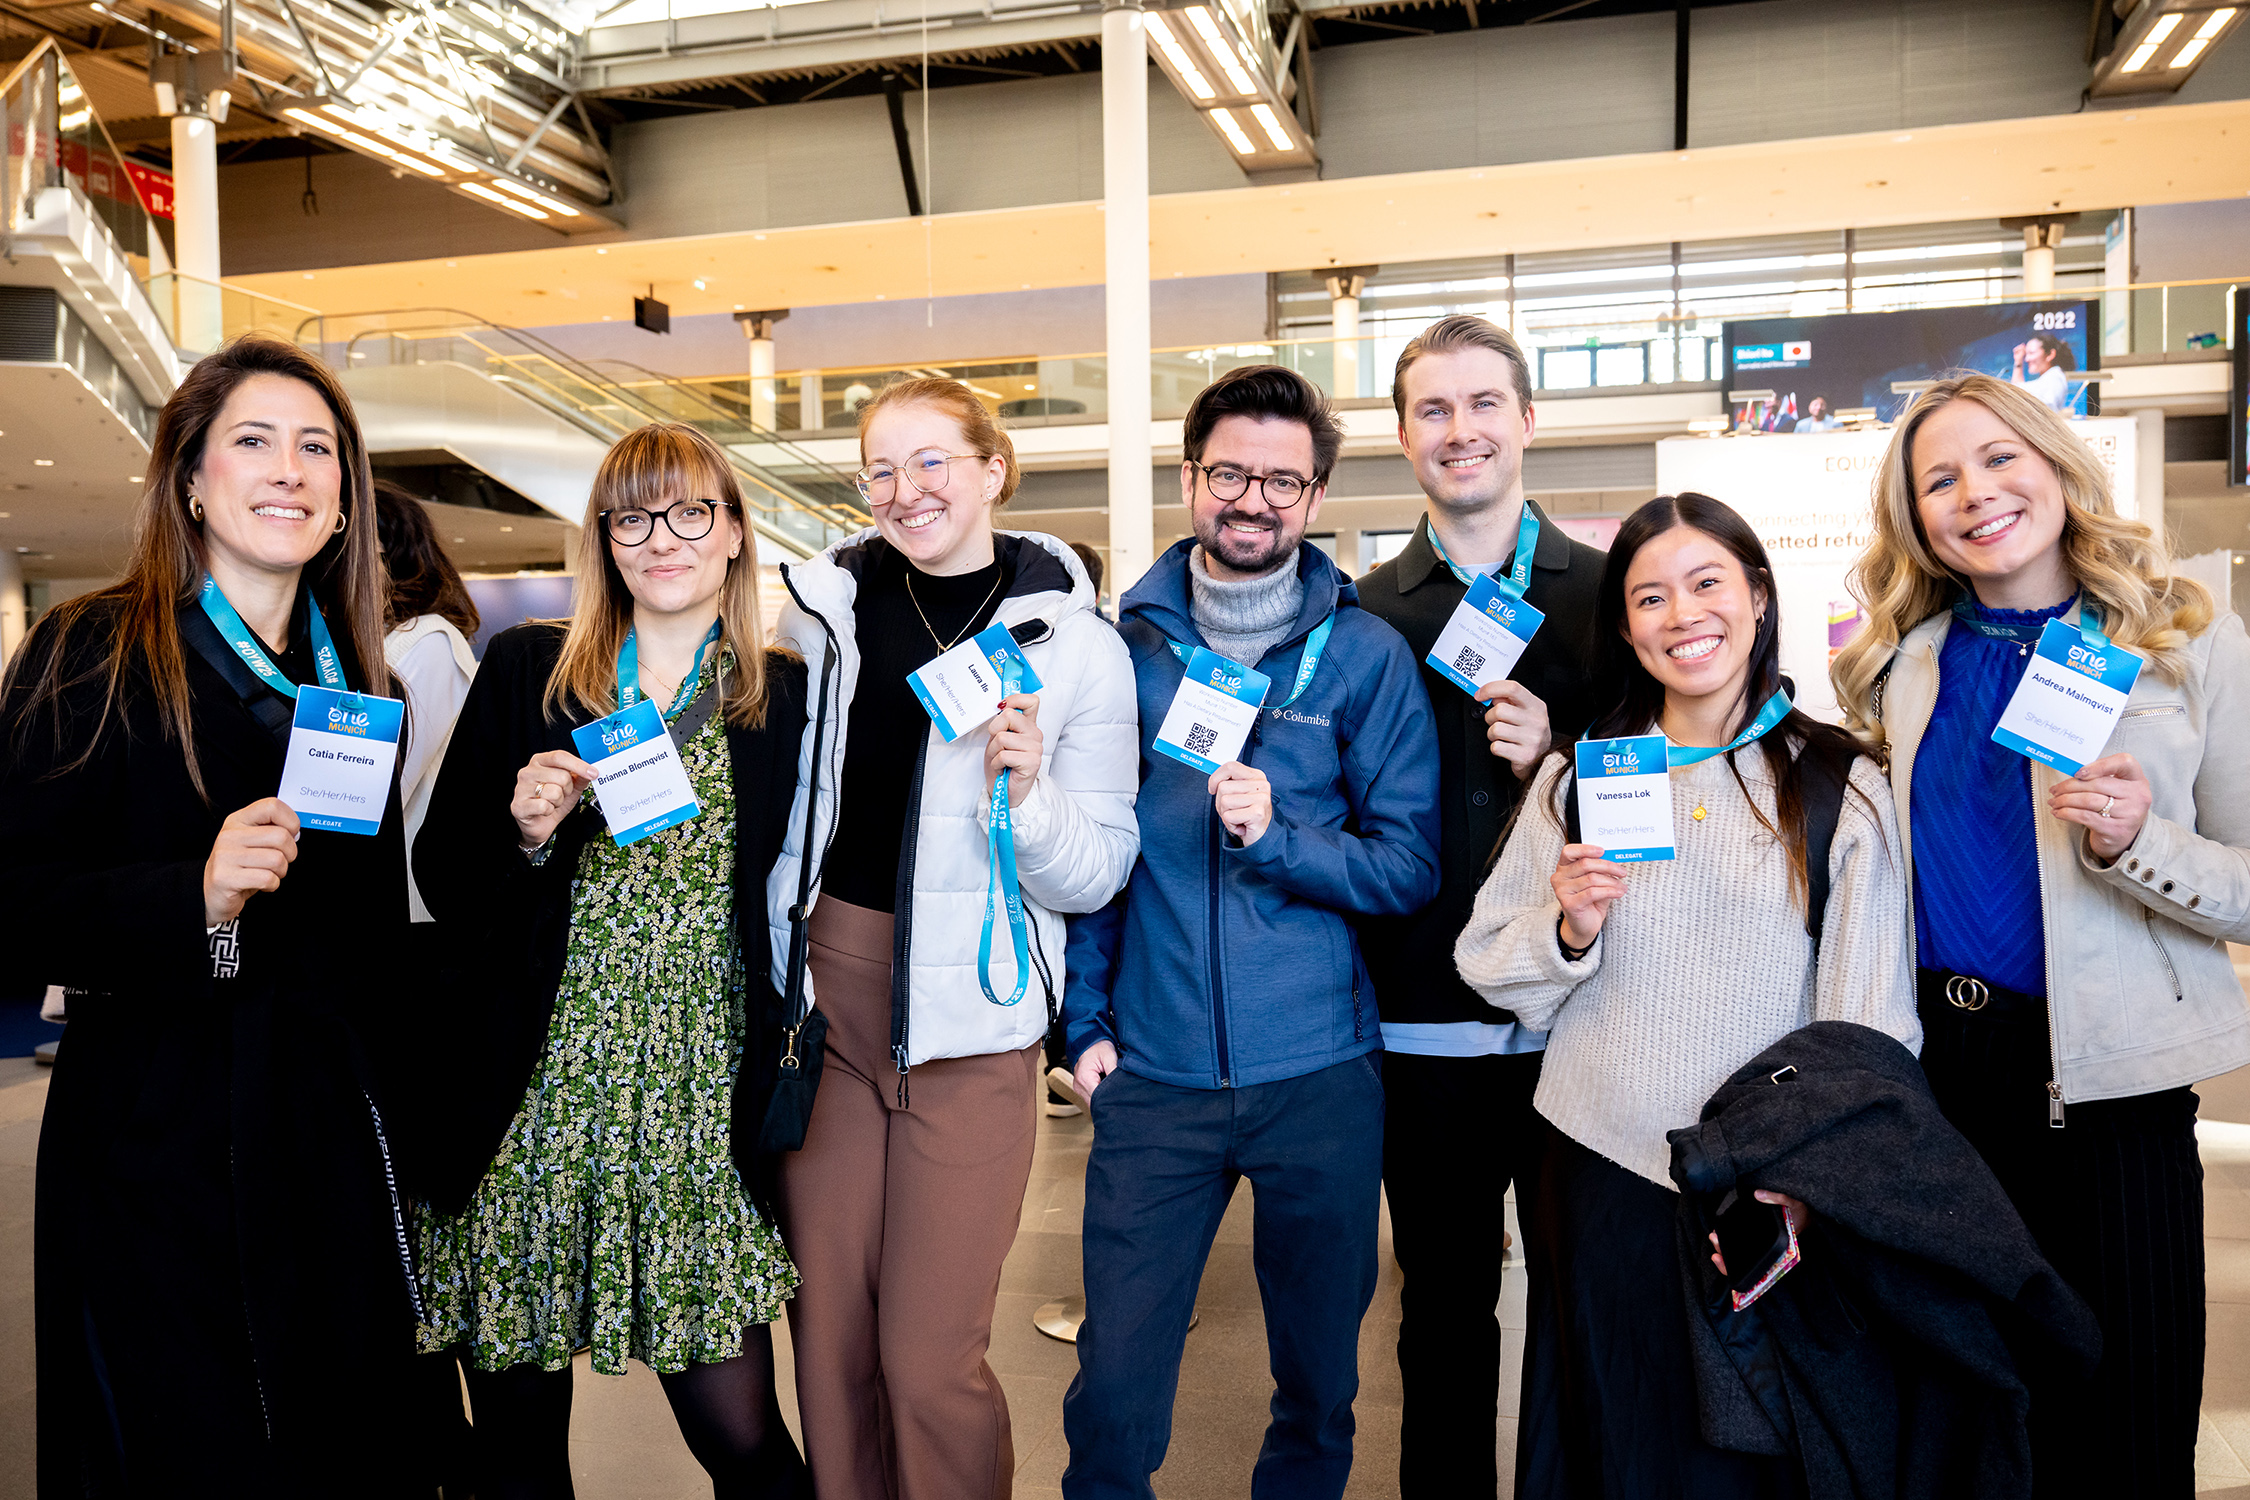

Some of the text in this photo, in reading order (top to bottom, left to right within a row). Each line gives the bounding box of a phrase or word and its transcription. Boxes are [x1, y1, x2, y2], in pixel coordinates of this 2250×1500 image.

[2033, 311, 2076, 331] 2022
[1485, 607, 1511, 628] MUNICH
[236, 640, 278, 677] #OYW25
[317, 646, 339, 684] #OYW25
[967, 663, 983, 684] Laura
[2065, 658, 2103, 680] MUNICH
[1209, 679, 1238, 697] MUNICH
[1448, 671, 1469, 689] DELEGATE
[935, 672, 967, 717] She/Her/Hers
[2031, 672, 2114, 715] Andrea Malmqvist
[922, 696, 939, 719] DELEGATE
[1220, 698, 1238, 709] Number
[1283, 709, 1330, 727] Columbia
[328, 722, 366, 736] MUNICH
[2024, 711, 2085, 745] She/Her/Hers
[607, 735, 639, 754] MUNICH
[308, 747, 375, 766] Catia Ferreira
[1180, 752, 1204, 767] DELEGATE
[2025, 745, 2055, 763] DELEGATE
[597, 750, 669, 786] Brianna Blomqvist
[1605, 765, 1639, 775] MUNICH
[299, 786, 366, 804] She/Her/Hers
[619, 788, 673, 815] She/Her/Hers
[1596, 789, 1651, 801] Vanessa Lok
[310, 818, 342, 828] DELEGATE
[643, 818, 670, 833] DELEGATE
[1597, 824, 1655, 837] She/Her/Hers
[1614, 852, 1643, 860] DELEGATE
